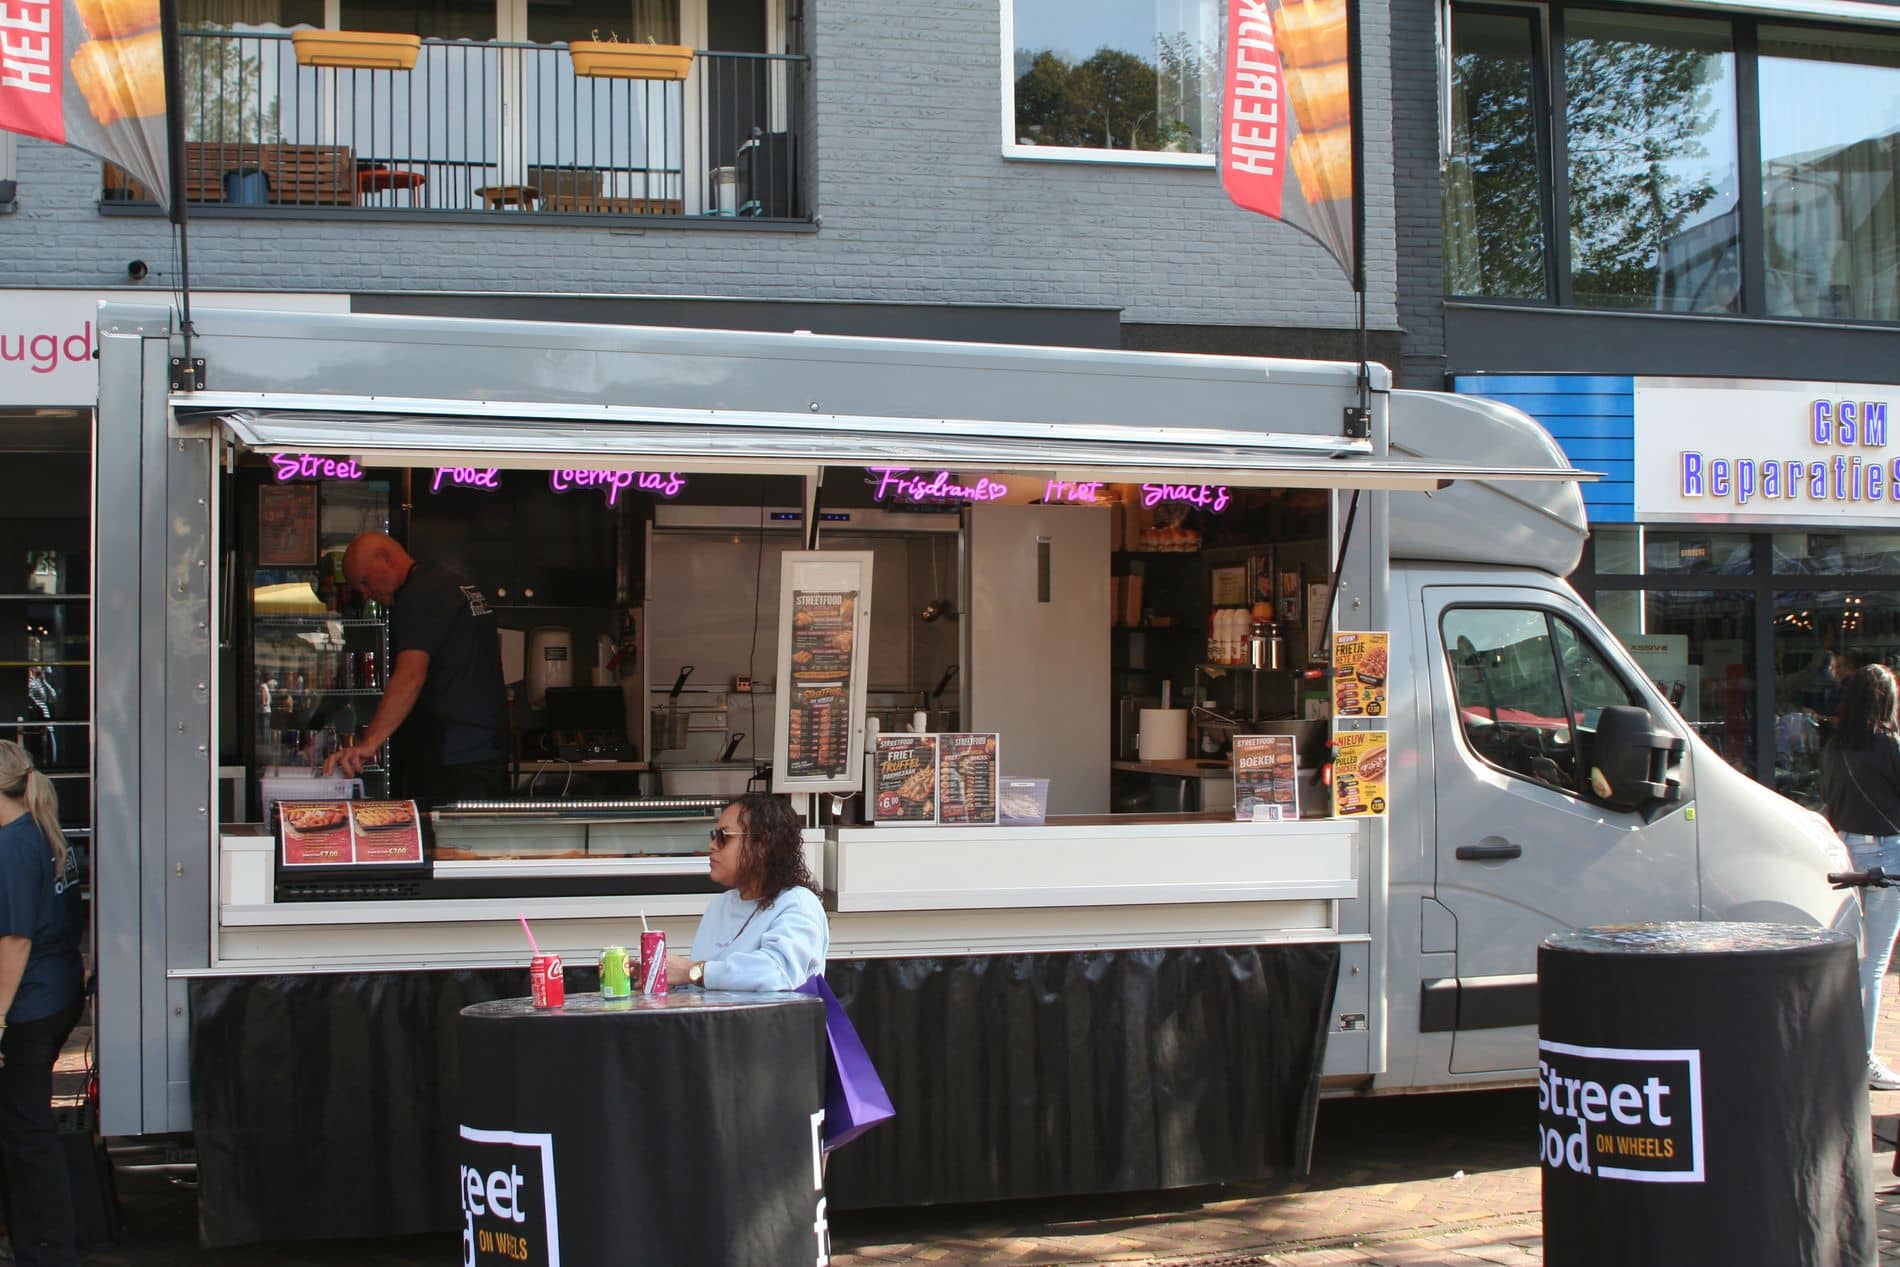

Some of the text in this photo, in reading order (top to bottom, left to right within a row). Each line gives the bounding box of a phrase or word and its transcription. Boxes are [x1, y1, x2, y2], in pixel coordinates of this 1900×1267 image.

[1811, 399, 1887, 447] GSM
[272, 453, 362, 480] Street
[869, 466, 989, 500] Frisdrank
[1336, 643, 1365, 655] FRIETJE
[1338, 734, 1365, 747] NIEUW
[880, 756, 921, 773] TRUFFEL
[888, 749, 914, 761] FRIET
[1239, 754, 1276, 769] BOEKEN
[1596, 1133, 1674, 1158] ON WHEELS
[479, 1229, 495, 1253] ON
